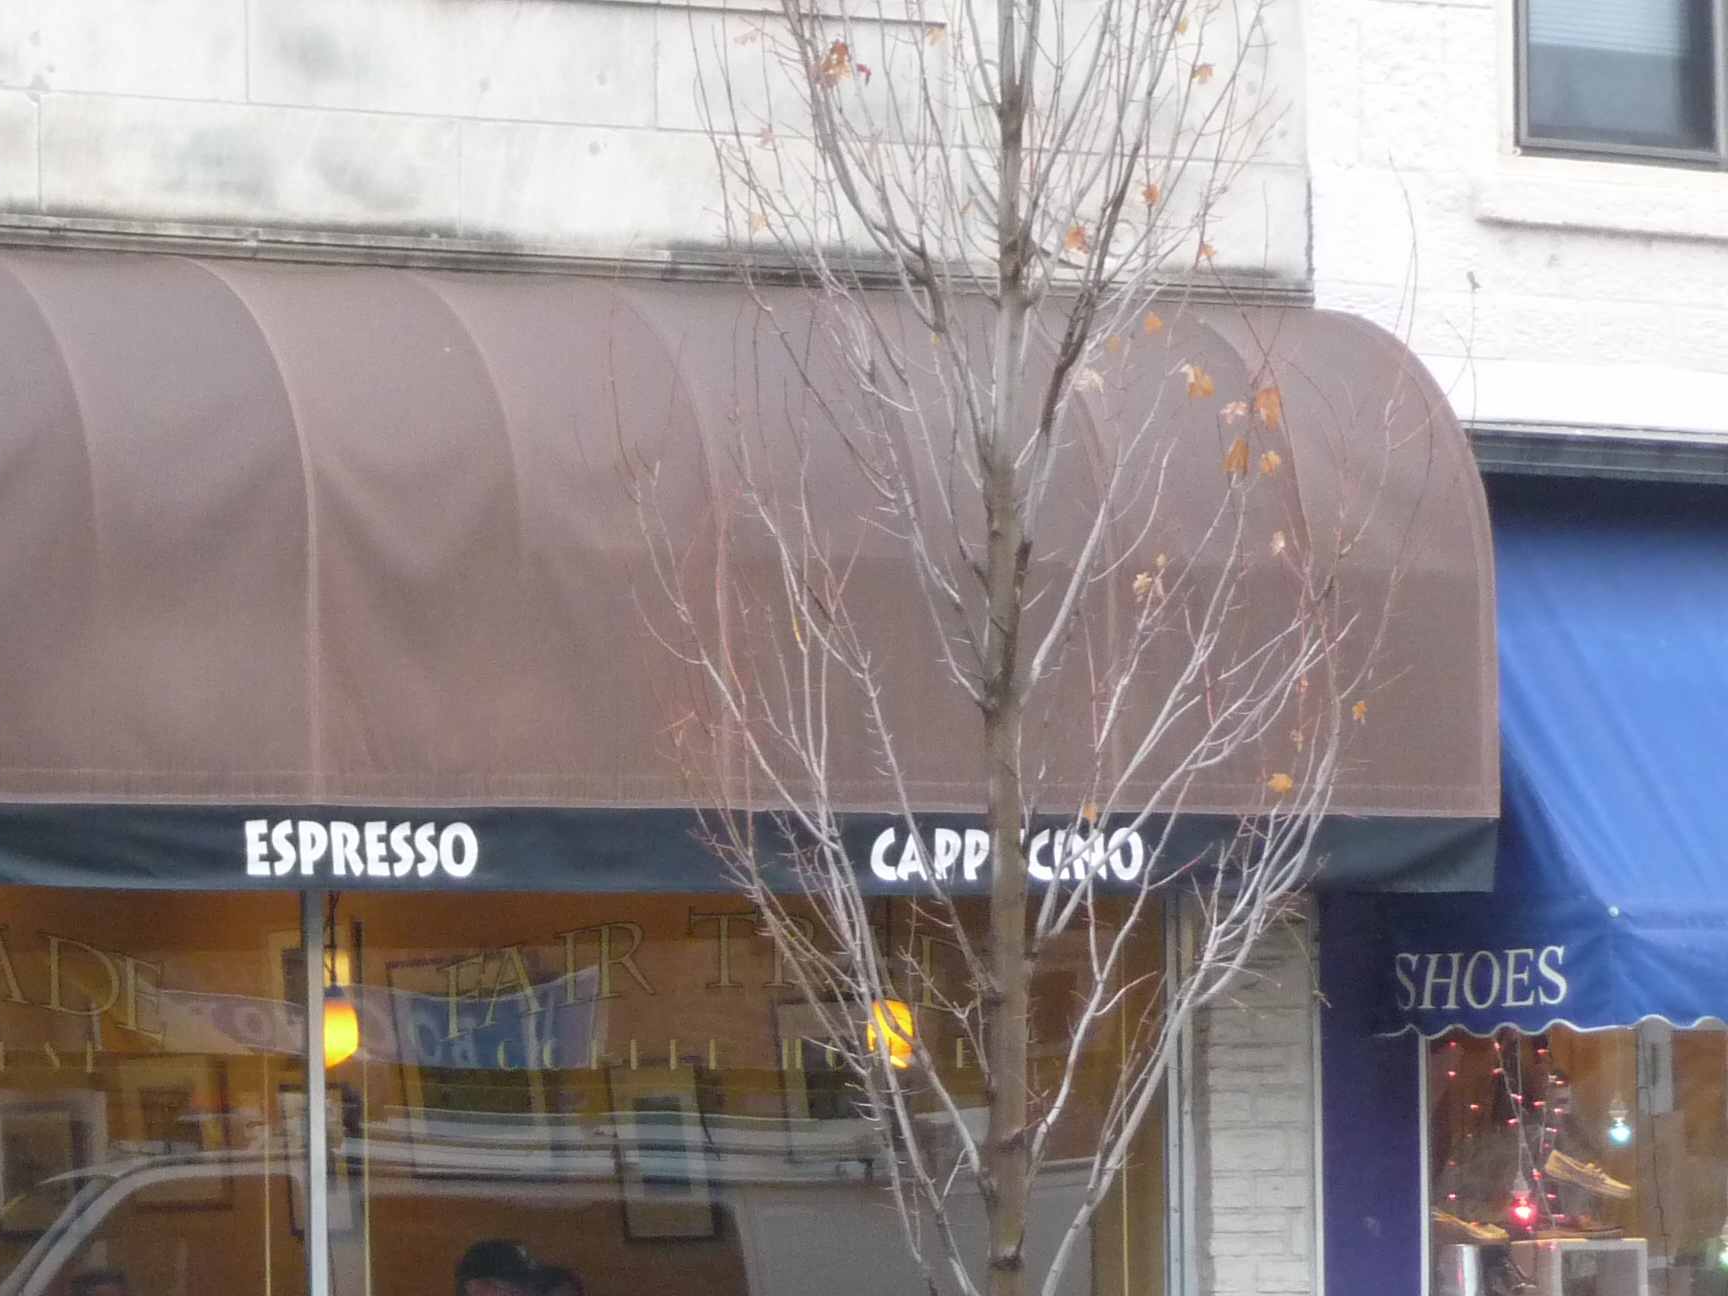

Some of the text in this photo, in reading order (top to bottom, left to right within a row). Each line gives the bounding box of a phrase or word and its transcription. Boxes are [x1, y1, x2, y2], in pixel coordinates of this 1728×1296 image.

[244, 818, 479, 878] ESPRESSO
[870, 826, 1144, 882] CAPPCINO
[434, 920, 658, 1043] FAIR
[1394, 945, 1569, 1011] SHOES
